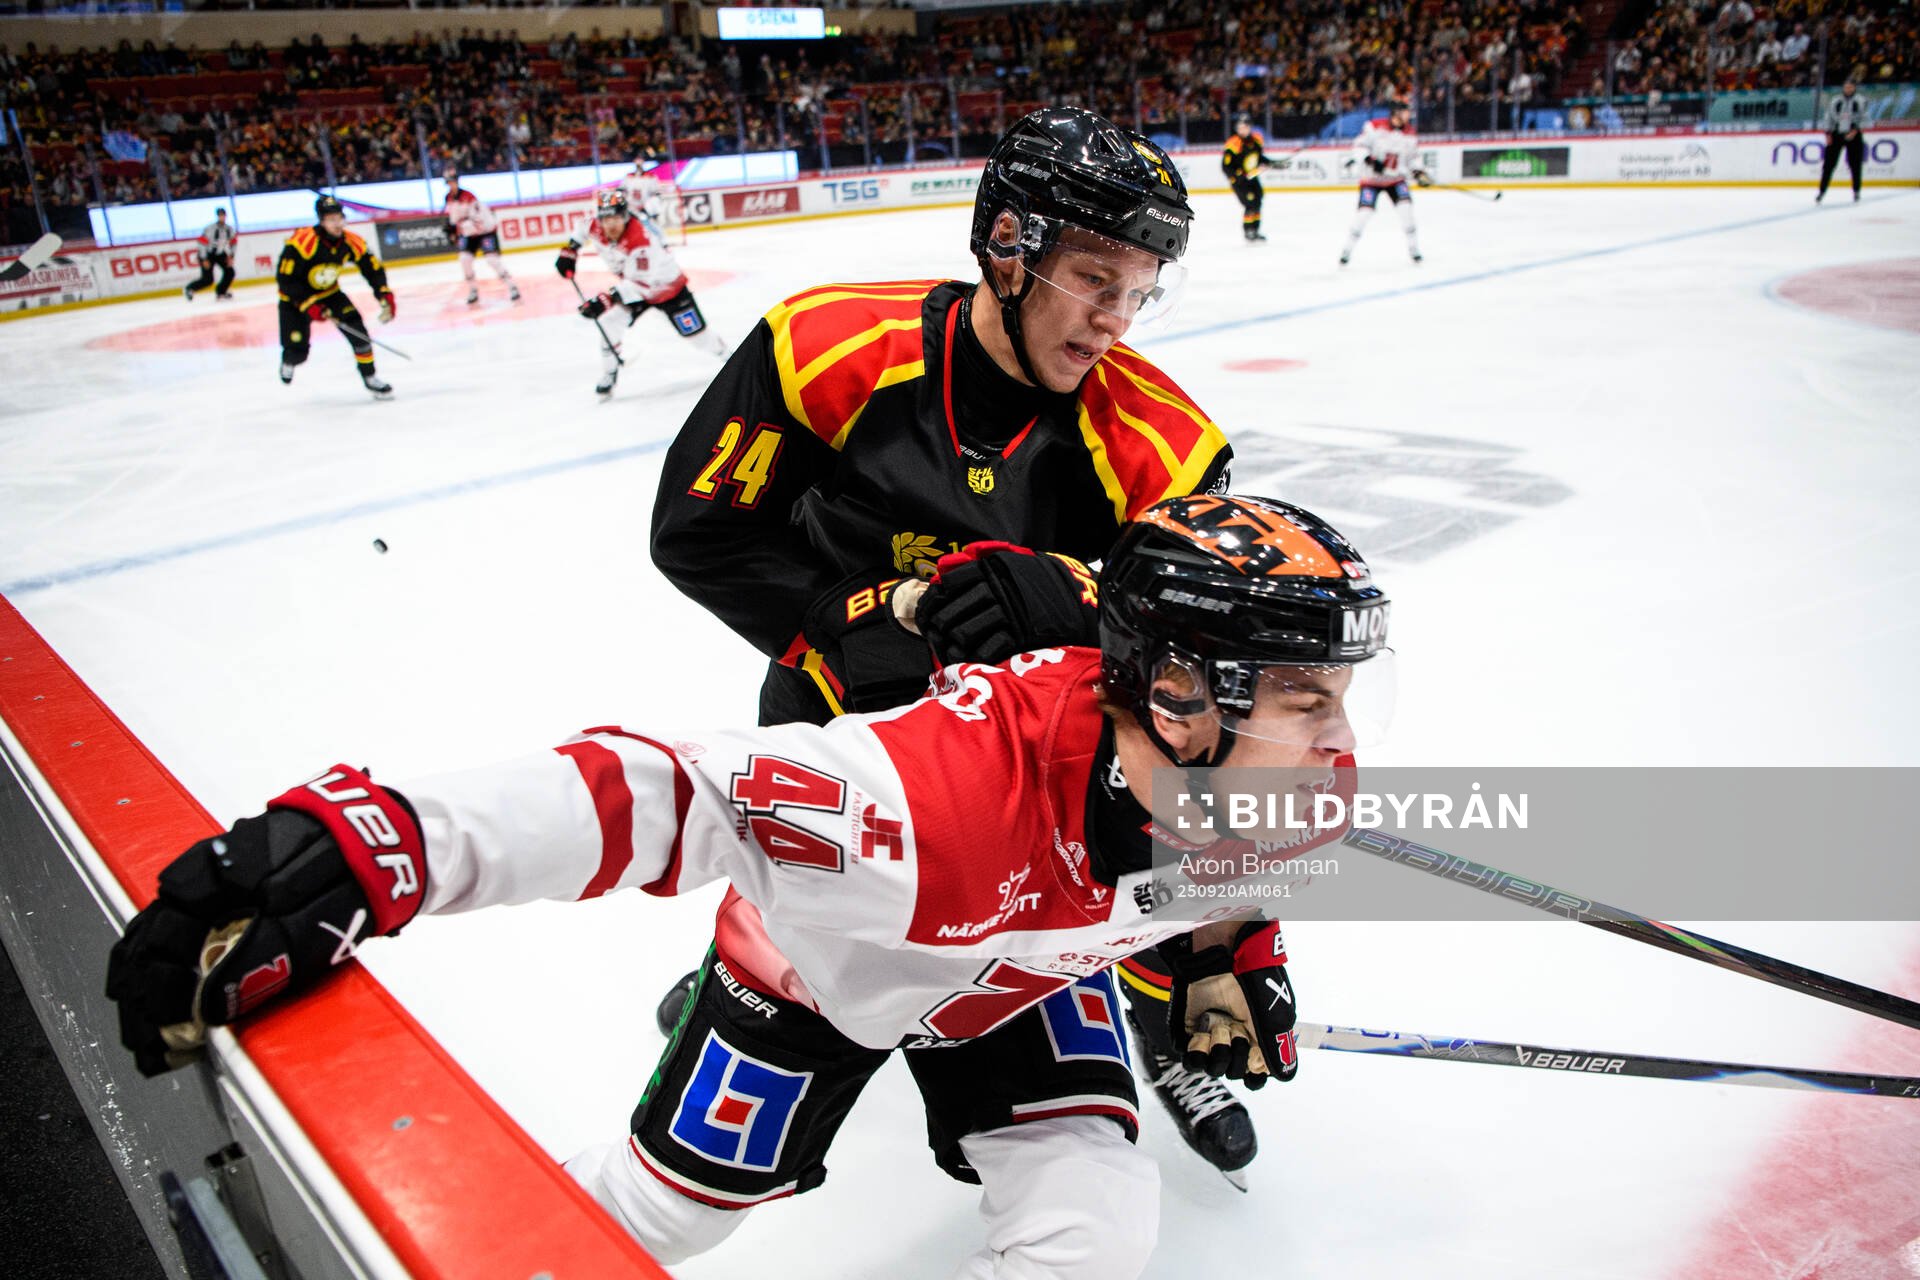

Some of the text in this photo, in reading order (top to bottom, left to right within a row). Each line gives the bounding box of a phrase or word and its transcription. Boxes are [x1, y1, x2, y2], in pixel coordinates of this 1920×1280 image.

[822, 179, 880, 202] TSG
[690, 418, 785, 510] 24
[1159, 587, 1235, 614] BAUER
[303, 768, 419, 902] UER
[729, 754, 847, 874] 44
[1350, 828, 1593, 921] BAUER
[713, 960, 780, 1020] BAUER
[1532, 1051, 1627, 1074] BAUER
